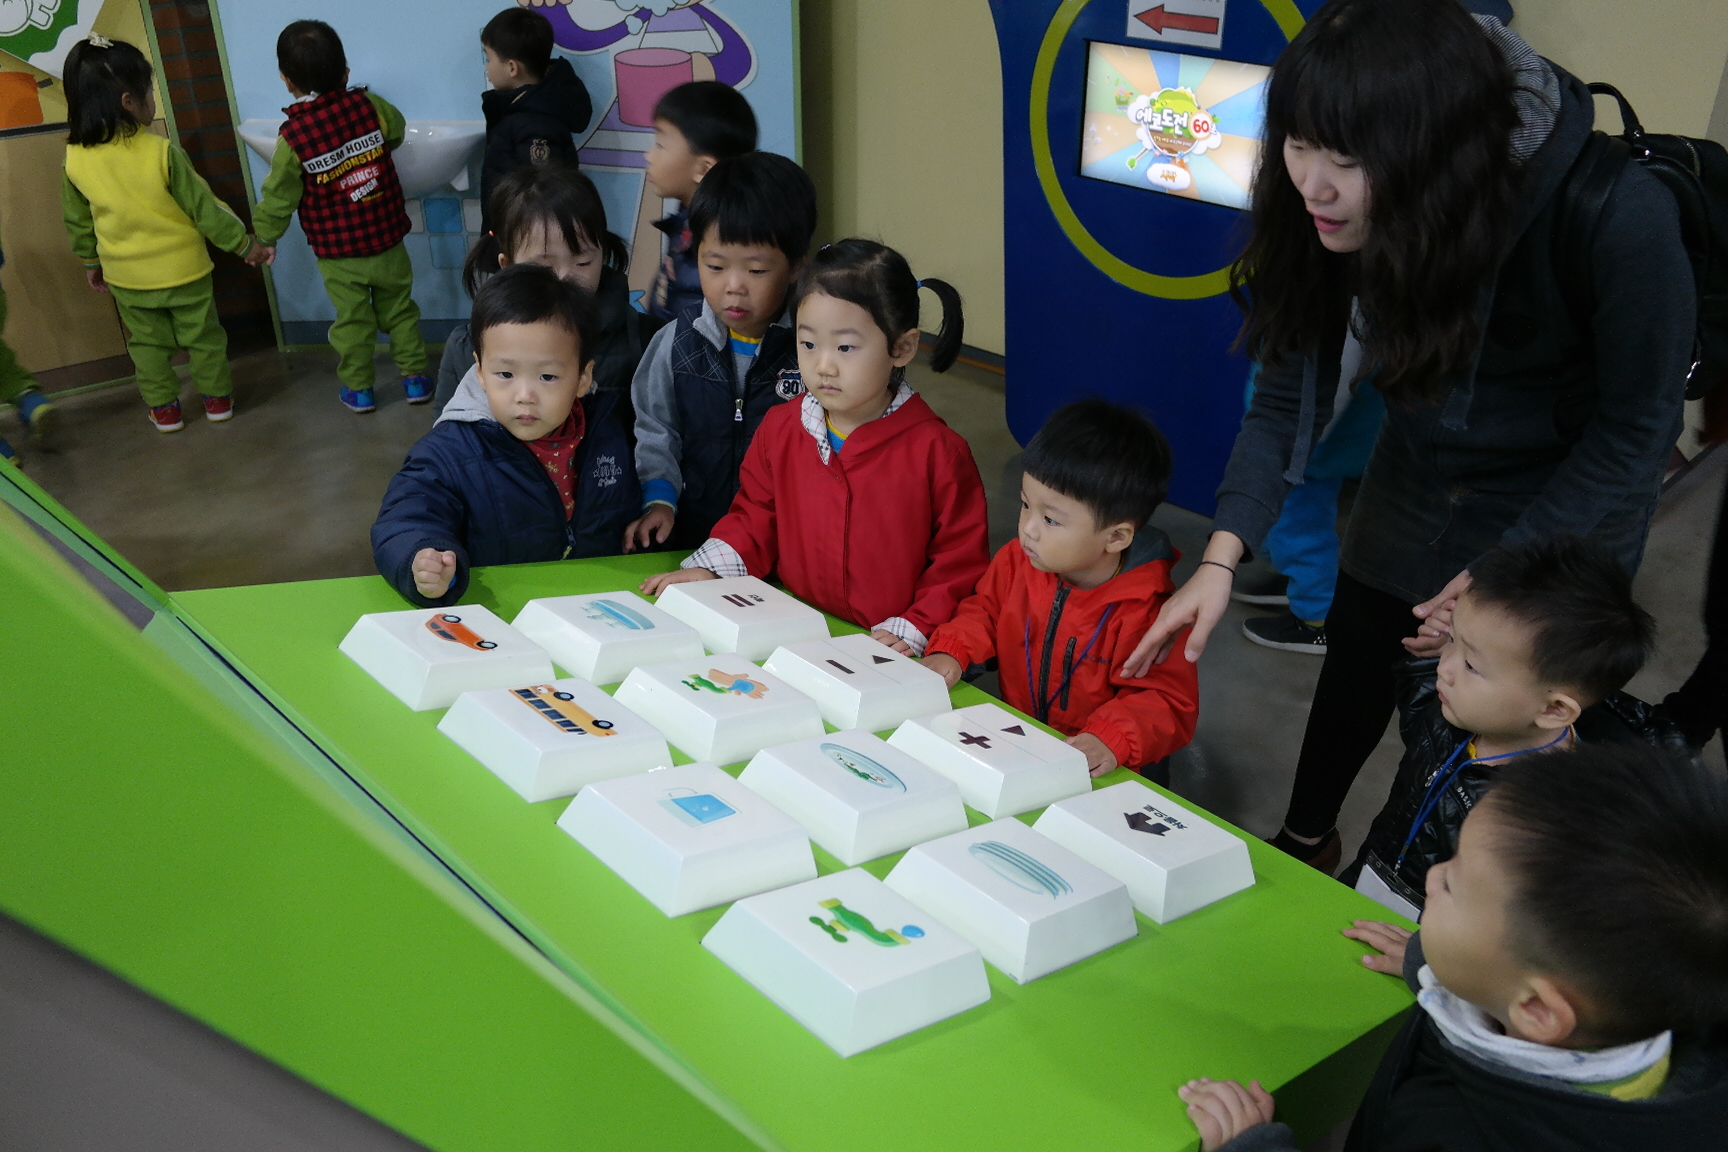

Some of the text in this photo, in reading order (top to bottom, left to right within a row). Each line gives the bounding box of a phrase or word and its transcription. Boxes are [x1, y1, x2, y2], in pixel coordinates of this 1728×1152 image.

[1136, 107, 1188, 135] 에코도전
[307, 134, 381, 172] DRESM HOUSE
[316, 146, 384, 184] FASHIONSTAR
[340, 166, 380, 189] PRINCE
[350, 178, 378, 202] DESIGN
[782, 380, 800, 395] 90
[1143, 804, 1188, 830] 처음으로
